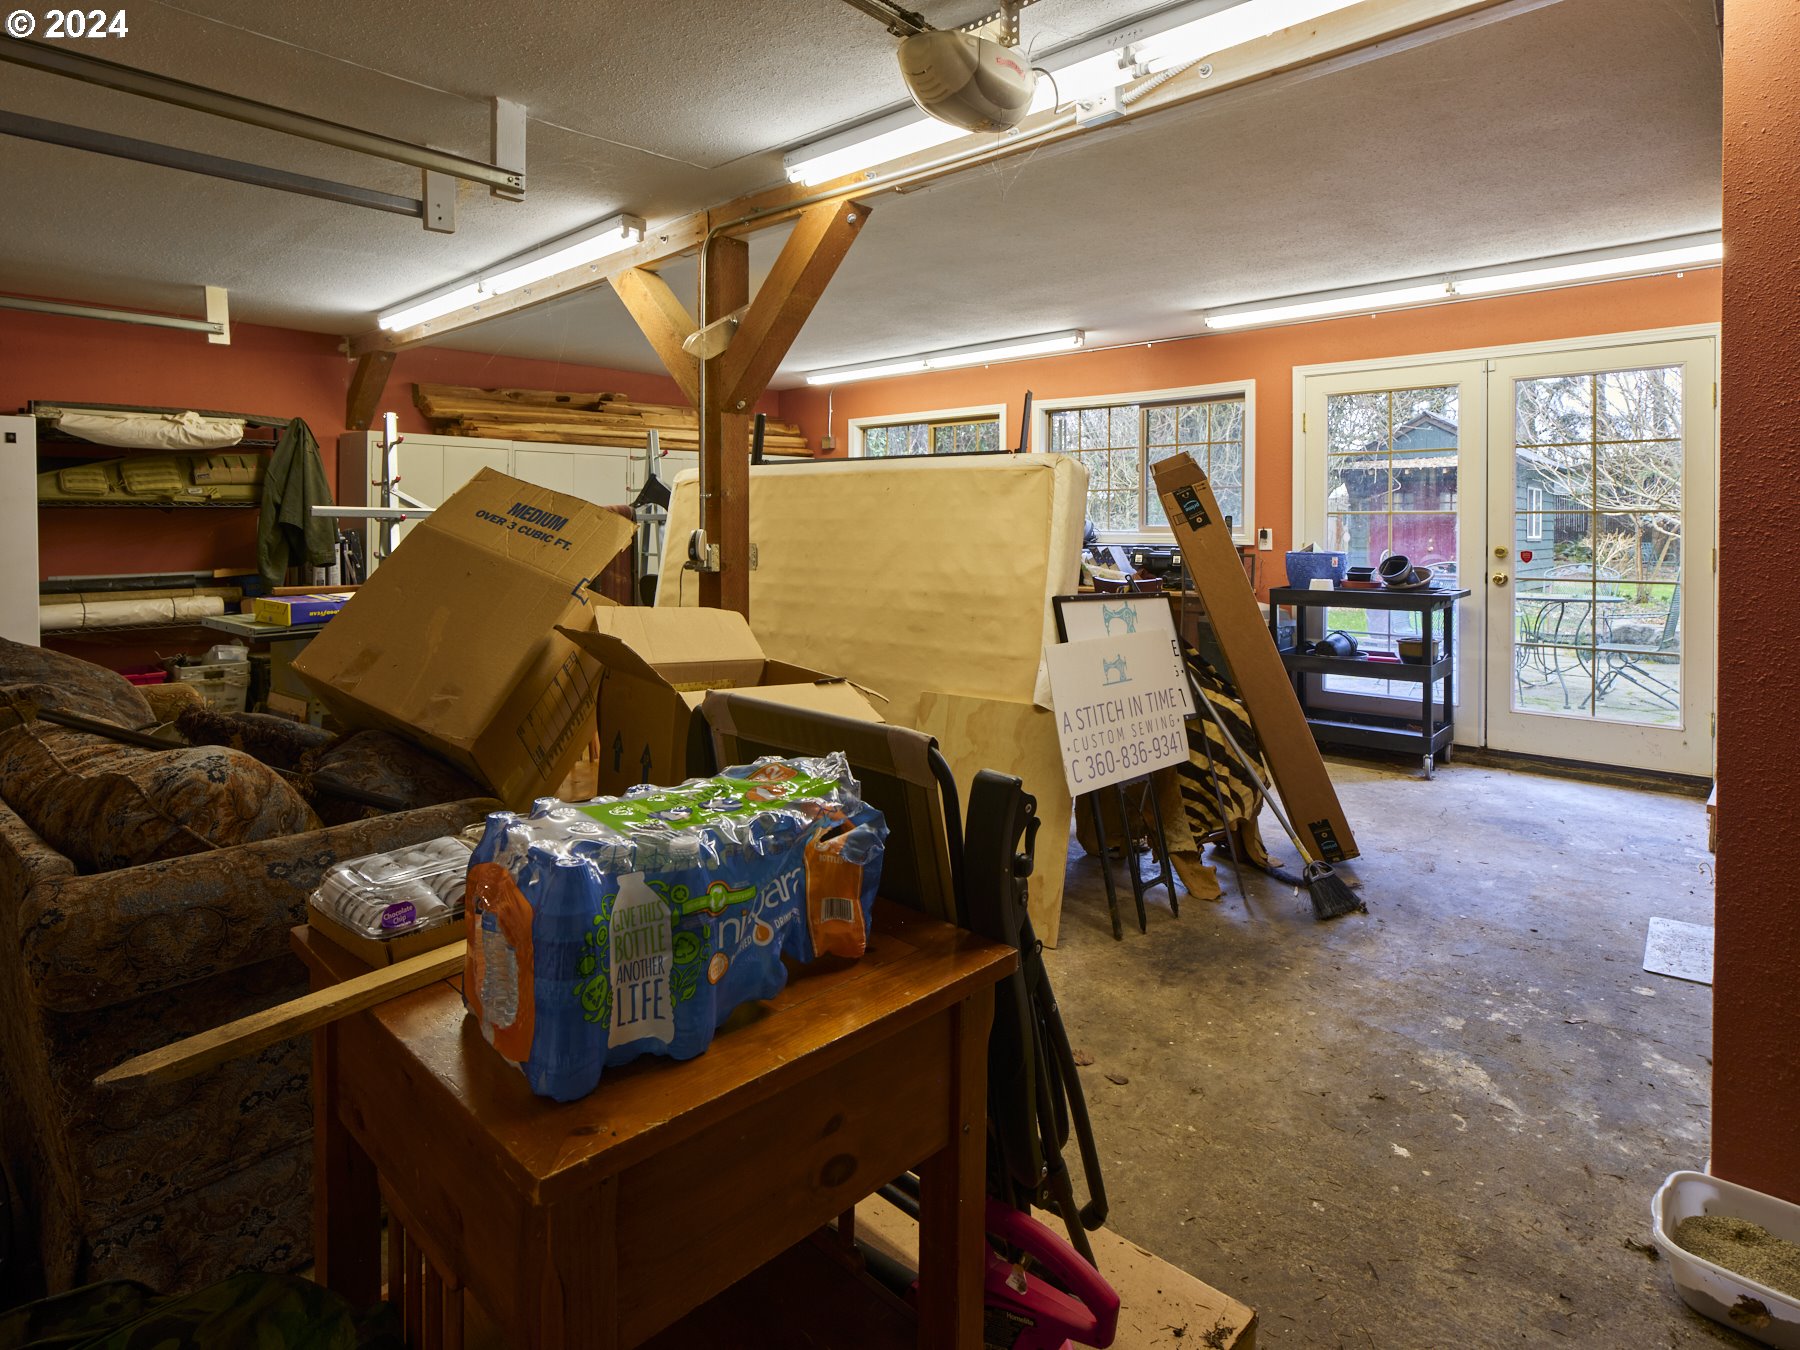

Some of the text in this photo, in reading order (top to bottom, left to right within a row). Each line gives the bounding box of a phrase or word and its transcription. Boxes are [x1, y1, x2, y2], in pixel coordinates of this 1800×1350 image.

[475, 510, 573, 551] OVER 3 CUBIC FT.
[506, 502, 569, 531] MEDIUM
[1063, 687, 1177, 734] A STITCH IN TIME
[1073, 714, 1175, 753] CUSTOM SEWING
[1071, 758, 1082, 784] C
[384, 906, 412, 920] Chocolate
[394, 916, 406, 925] Chip
[612, 900, 665, 933] GIVE THIS
[614, 923, 667, 964] BOTTLE
[616, 955, 666, 985] ANOTHER
[616, 978, 666, 1028] LIFE
